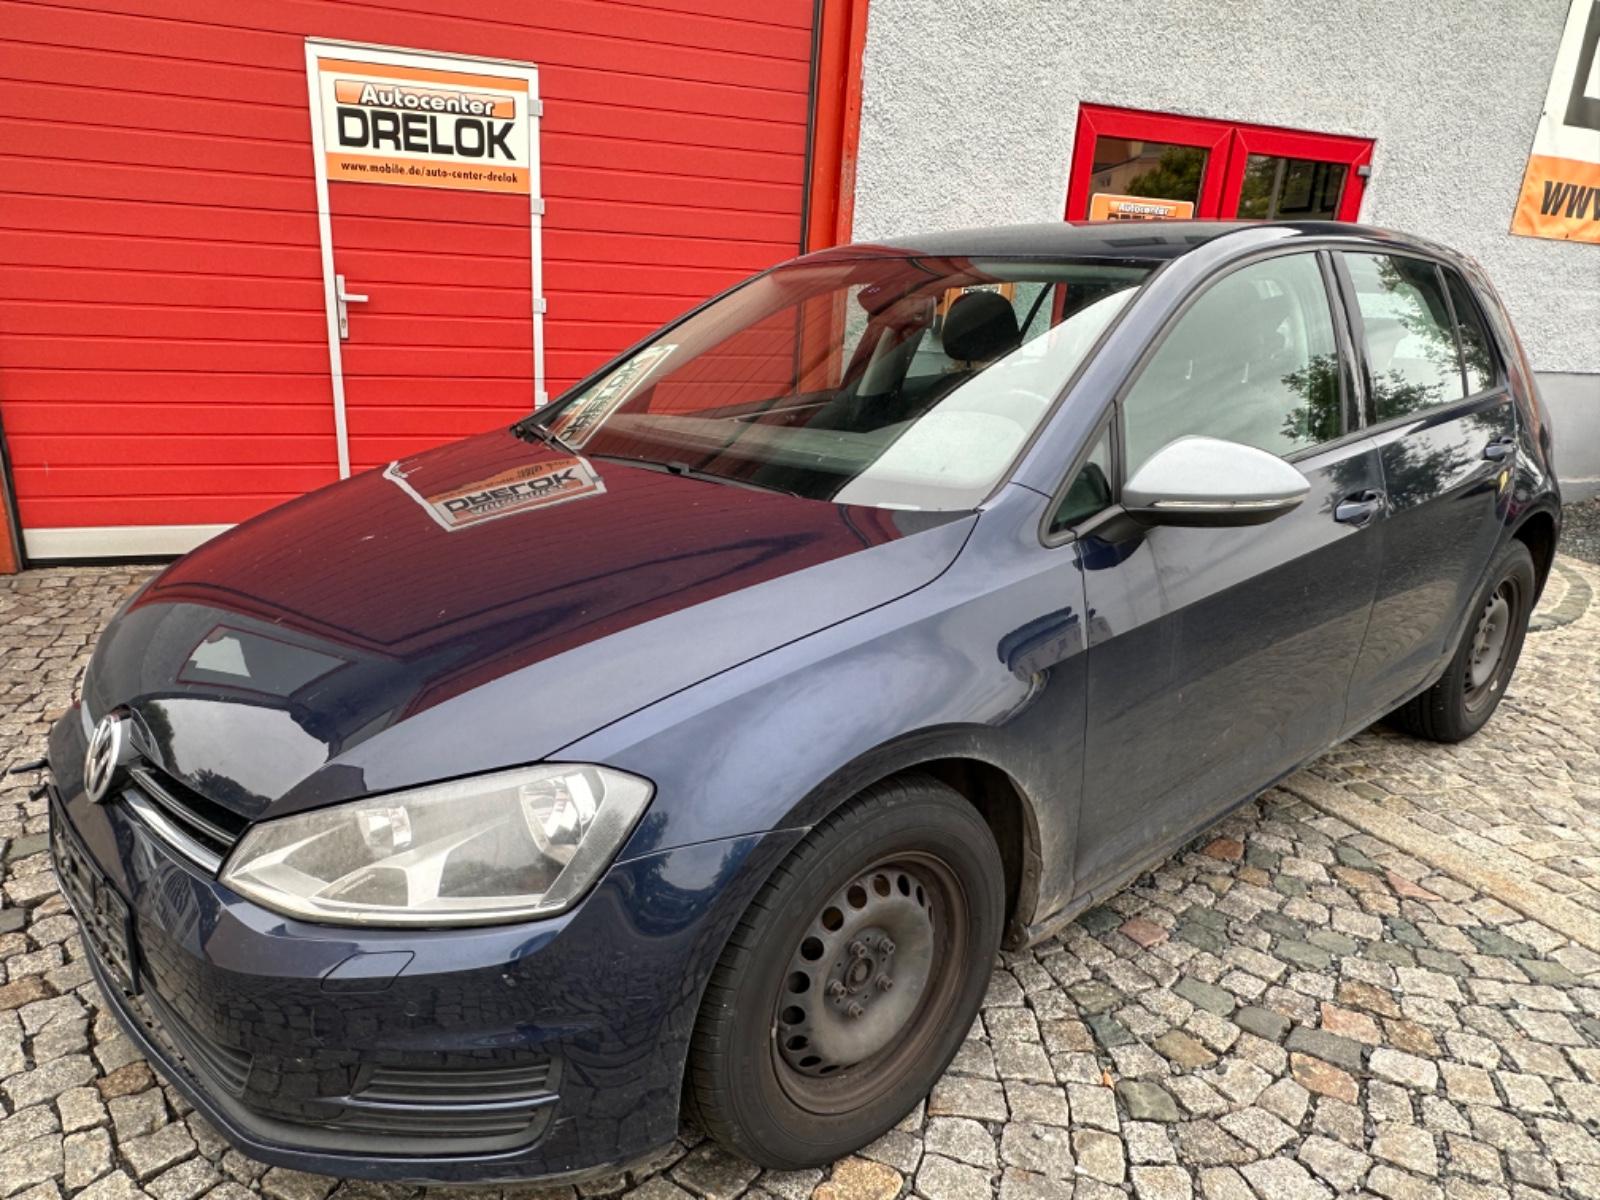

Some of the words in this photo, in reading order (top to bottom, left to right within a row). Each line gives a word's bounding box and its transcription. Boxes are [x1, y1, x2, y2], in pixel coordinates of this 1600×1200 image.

[359, 83, 496, 117] Autocenter
[336, 105, 517, 161] DRELOK
[340, 162, 519, 184] www.mobile.de/auto-center-drelok
